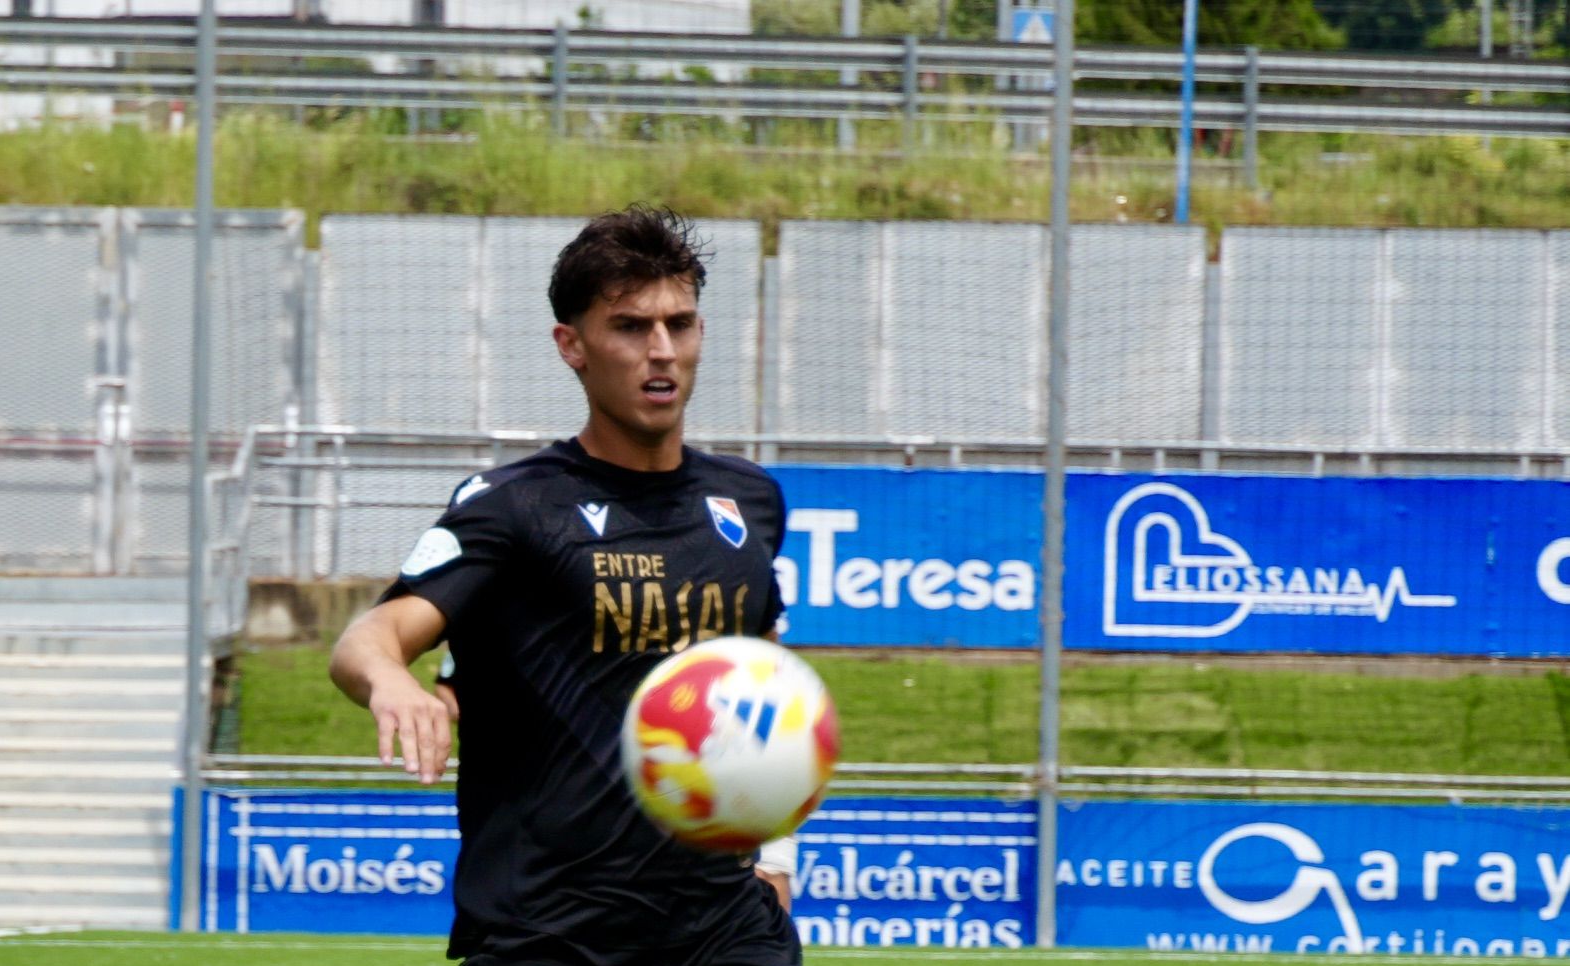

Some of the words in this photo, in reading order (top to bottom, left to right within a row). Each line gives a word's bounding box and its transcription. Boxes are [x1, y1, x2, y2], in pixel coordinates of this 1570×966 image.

[592, 551, 667, 578] ENTRE
[251, 844, 445, 895] Moisés
[1056, 858, 1193, 888] ACEITE
